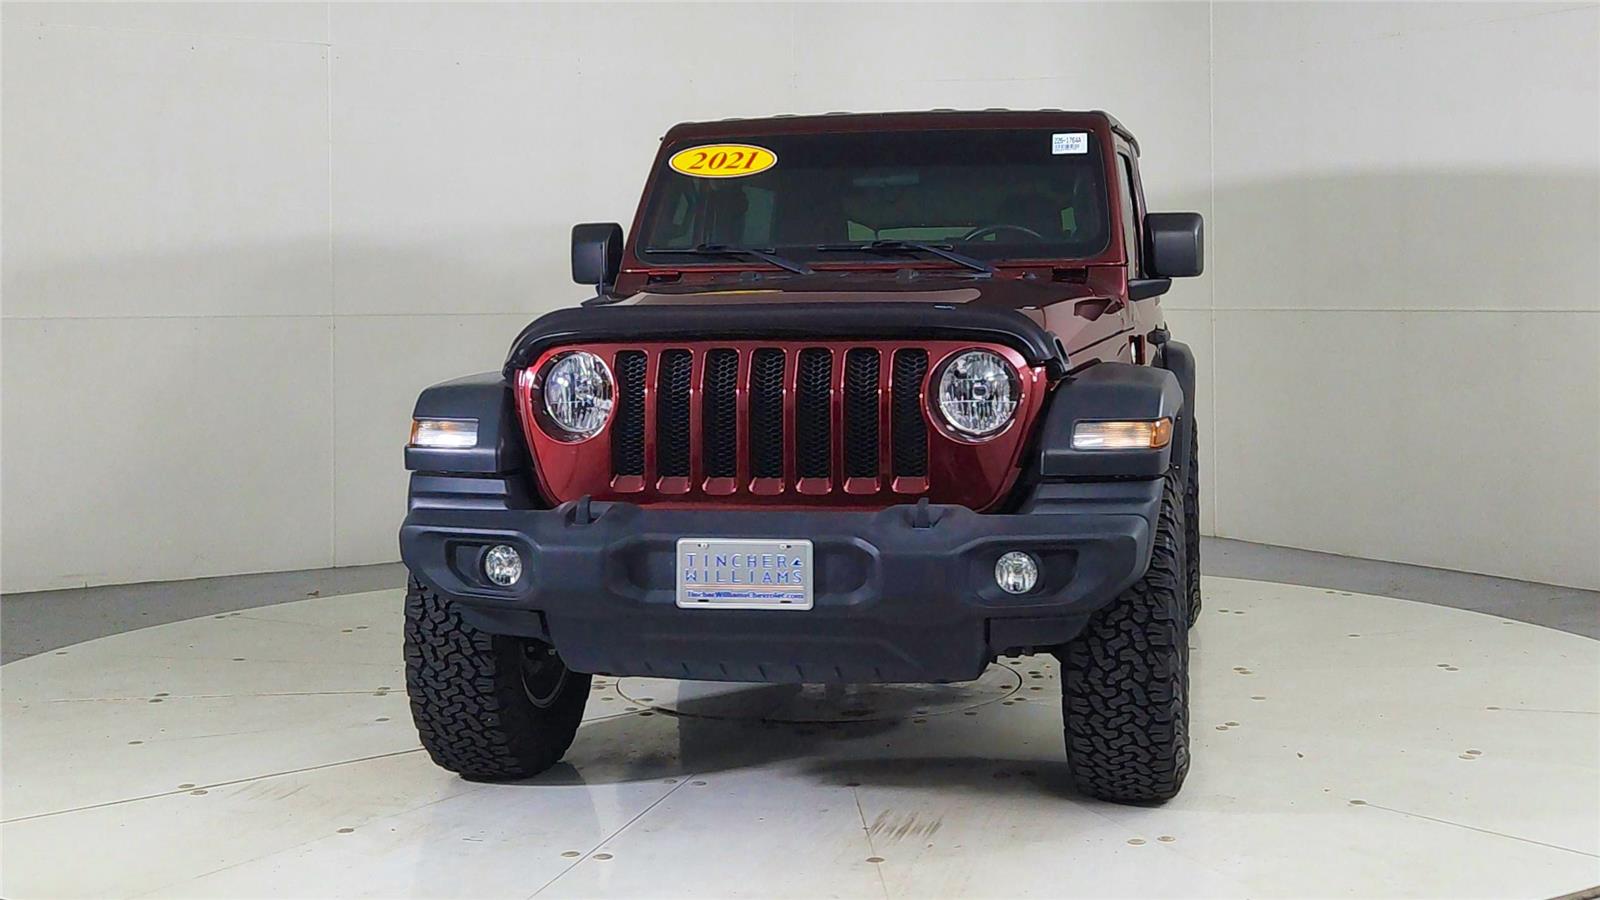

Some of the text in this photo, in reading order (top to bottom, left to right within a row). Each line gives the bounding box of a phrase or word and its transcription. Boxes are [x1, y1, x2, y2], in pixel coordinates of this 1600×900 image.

[687, 151, 759, 170] 2021
[686, 554, 787, 568] TINCHER
[685, 570, 803, 583] WILLIAMS
